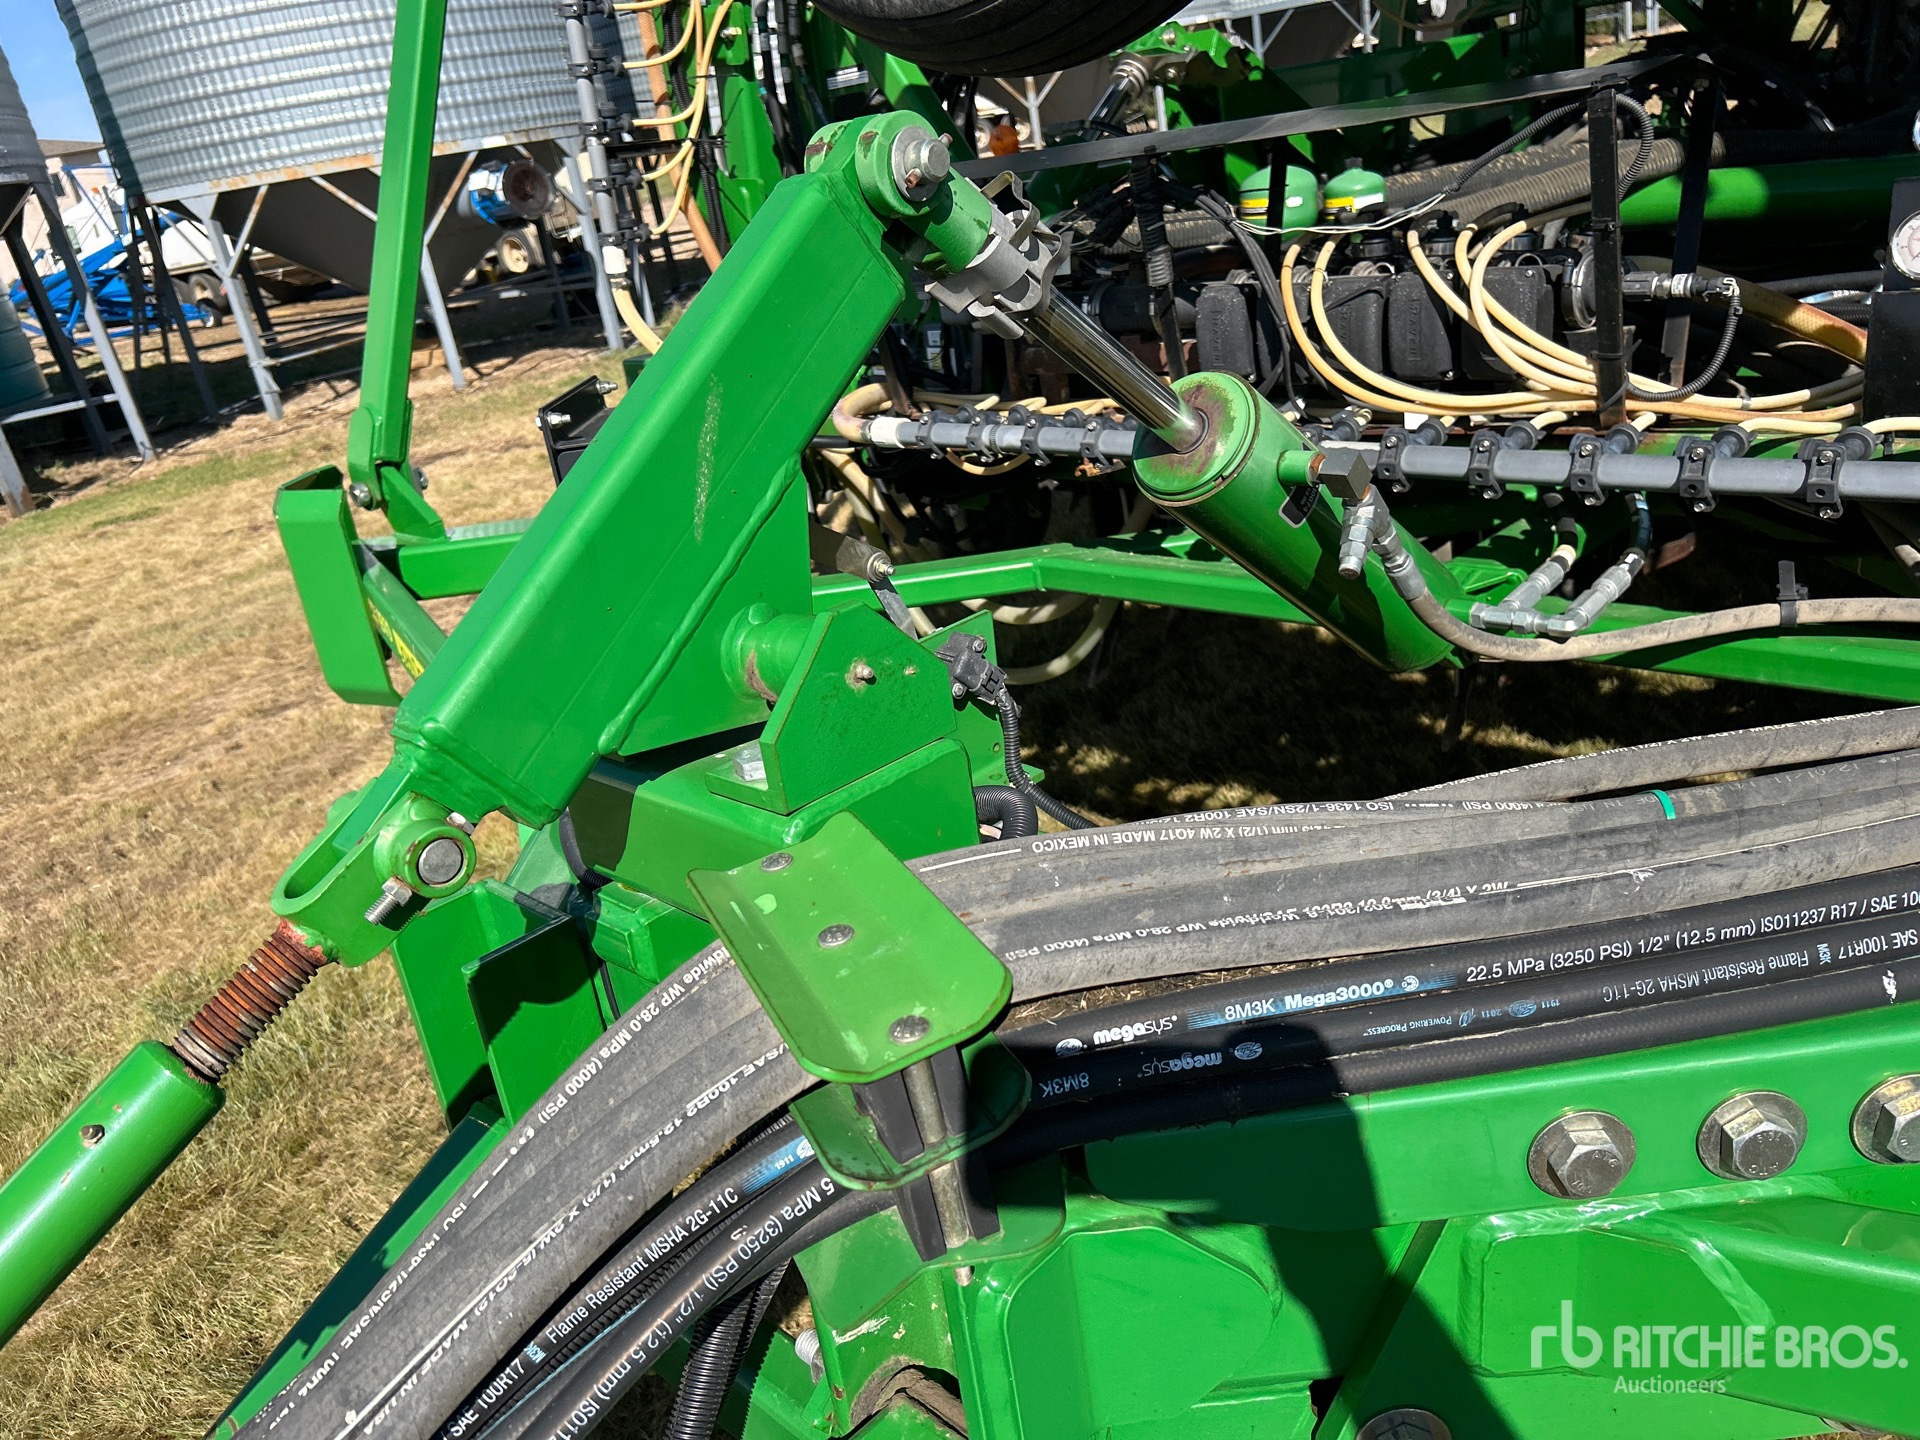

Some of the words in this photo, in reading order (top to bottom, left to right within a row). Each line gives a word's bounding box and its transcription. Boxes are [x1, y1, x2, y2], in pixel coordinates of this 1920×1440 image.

[1365, 801, 1394, 811] ISO
[1462, 801, 1493, 811] PSI)
[1031, 835, 1090, 853] MEXICO
[1092, 833, 1109, 846] IN
[1111, 830, 1156, 844] MADE
[1159, 828, 1196, 841] 4Q17
[1199, 827, 1222, 839] 2W
[1224, 827, 1236, 839] X
[1175, 923, 1207, 933] WP
[1890, 929, 1918, 949] SAE
[1224, 998, 1279, 1021] 8M3K
[1466, 962, 1503, 982] 22.5
[1507, 957, 1545, 976] MPa
[1549, 947, 1595, 971] (3250
[1599, 939, 1633, 961] PSI)
[1637, 934, 1670, 954] 1/2"
[1676, 926, 1716, 949] (12.5
[1720, 918, 1756, 940] mm)
[1760, 907, 1827, 933] ISO11237
[1830, 901, 1858, 920] R17
[1860, 898, 1868, 915] /
[1870, 893, 1898, 913] SAE
[1816, 943, 1832, 965] M3K
[1838, 935, 1889, 960] 100R17
[682, 946, 731, 984] ldwide
[1701, 958, 1765, 984] Resistant
[1767, 950, 1809, 970] Flame
[1602, 978, 1655, 1002] 2G-11C
[1656, 970, 1700, 992] MSHA
[661, 983, 686, 1007] WP
[1541, 999, 1560, 1009] 1911
[1481, 1008, 1501, 1018] 2011
[599, 1029, 632, 1059] MPa
[565, 1057, 603, 1096] (4000
[1039, 1072, 1090, 1098] 8M3K
[537, 1092, 568, 1124] PSI)
[780, 1186, 822, 1221] MPa
[734, 1214, 783, 1260] (3250
[701, 1253, 739, 1291] PSI)
[450, 1409, 480, 1437] SAE
[477, 1357, 525, 1409] 100R17
[545, 1306, 589, 1344] Flame
[584, 1255, 649, 1309] Resistant
[642, 1225, 688, 1262] MSHA
[685, 1187, 738, 1232] 2G-11C
[774, 1154, 795, 1171] 1911
[675, 1285, 701, 1324] 1/2"
[626, 1316, 673, 1363] (12.5
[592, 1357, 632, 1400] mm)
[549, 1394, 600, 1440] ISO11
